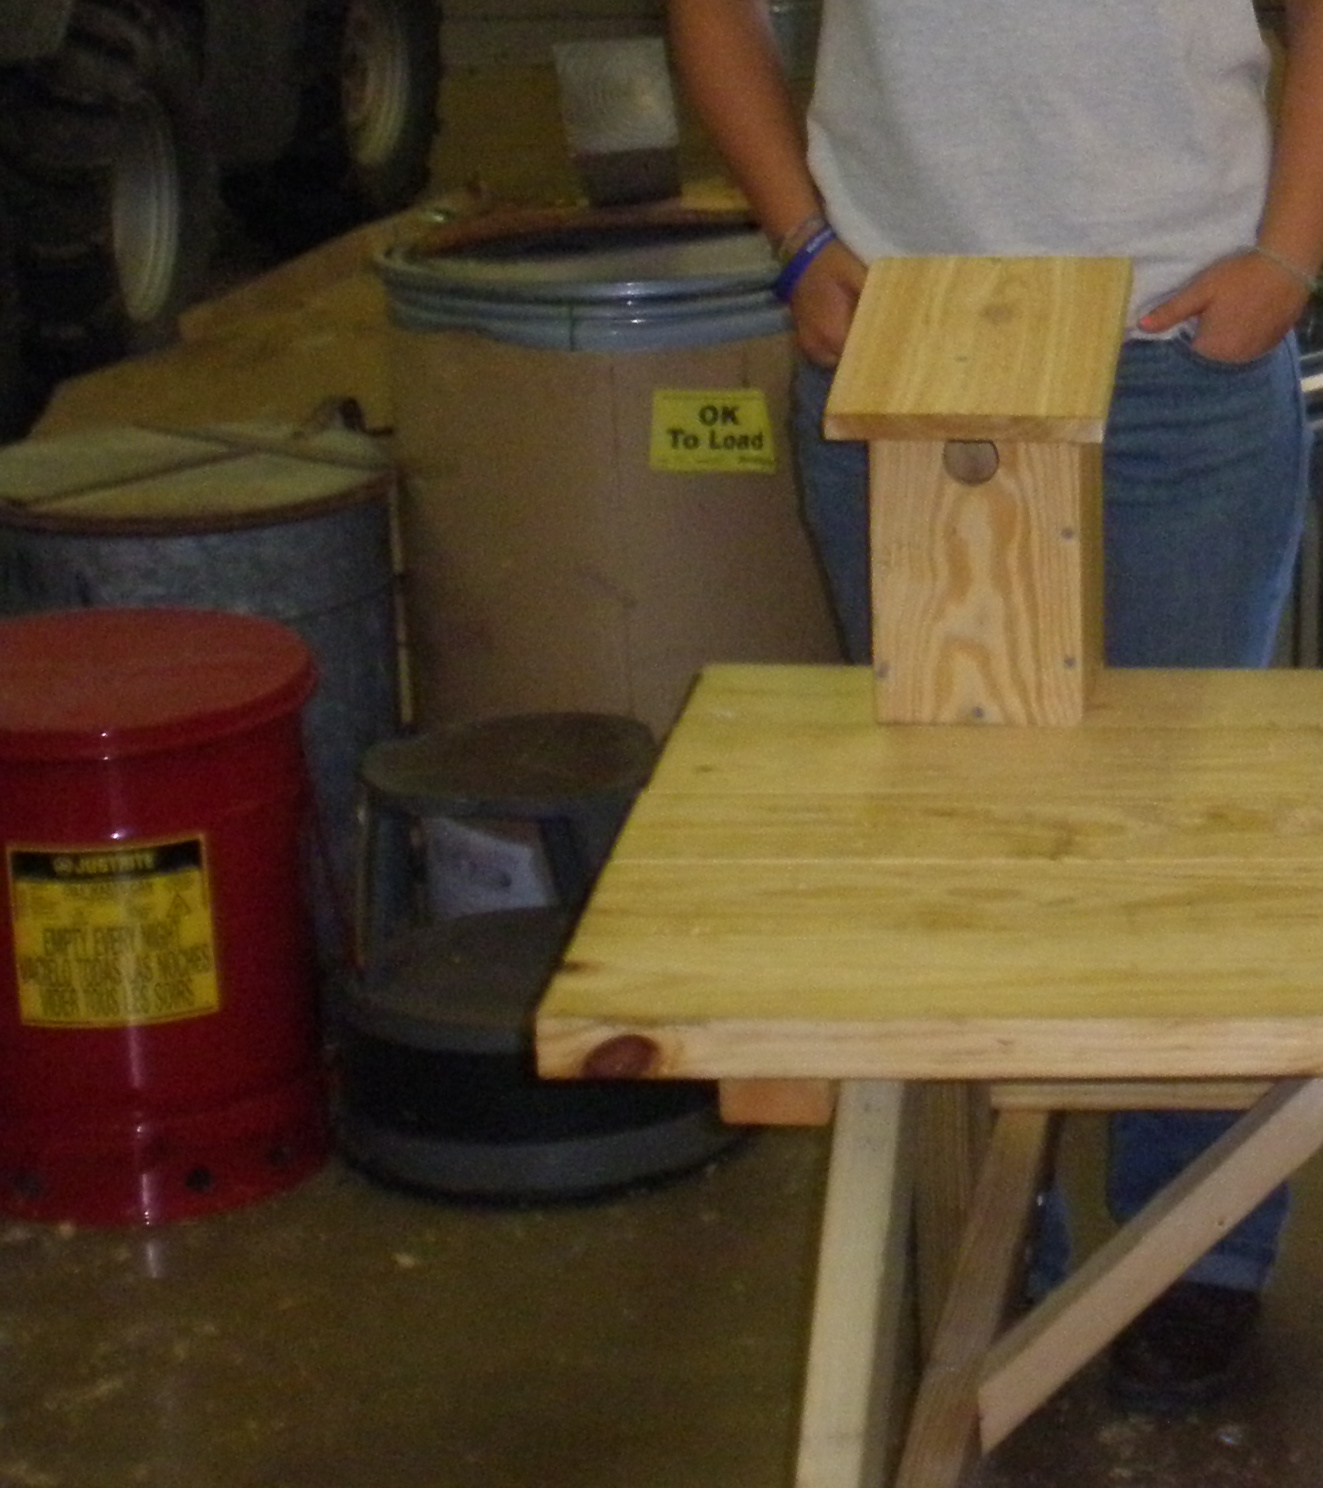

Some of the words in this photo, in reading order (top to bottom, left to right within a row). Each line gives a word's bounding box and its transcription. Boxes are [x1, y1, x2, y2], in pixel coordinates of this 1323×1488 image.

[697, 405, 740, 427] OK
[666, 427, 699, 450] To
[708, 427, 764, 450] Load
[43, 926, 87, 957] EMPTY
